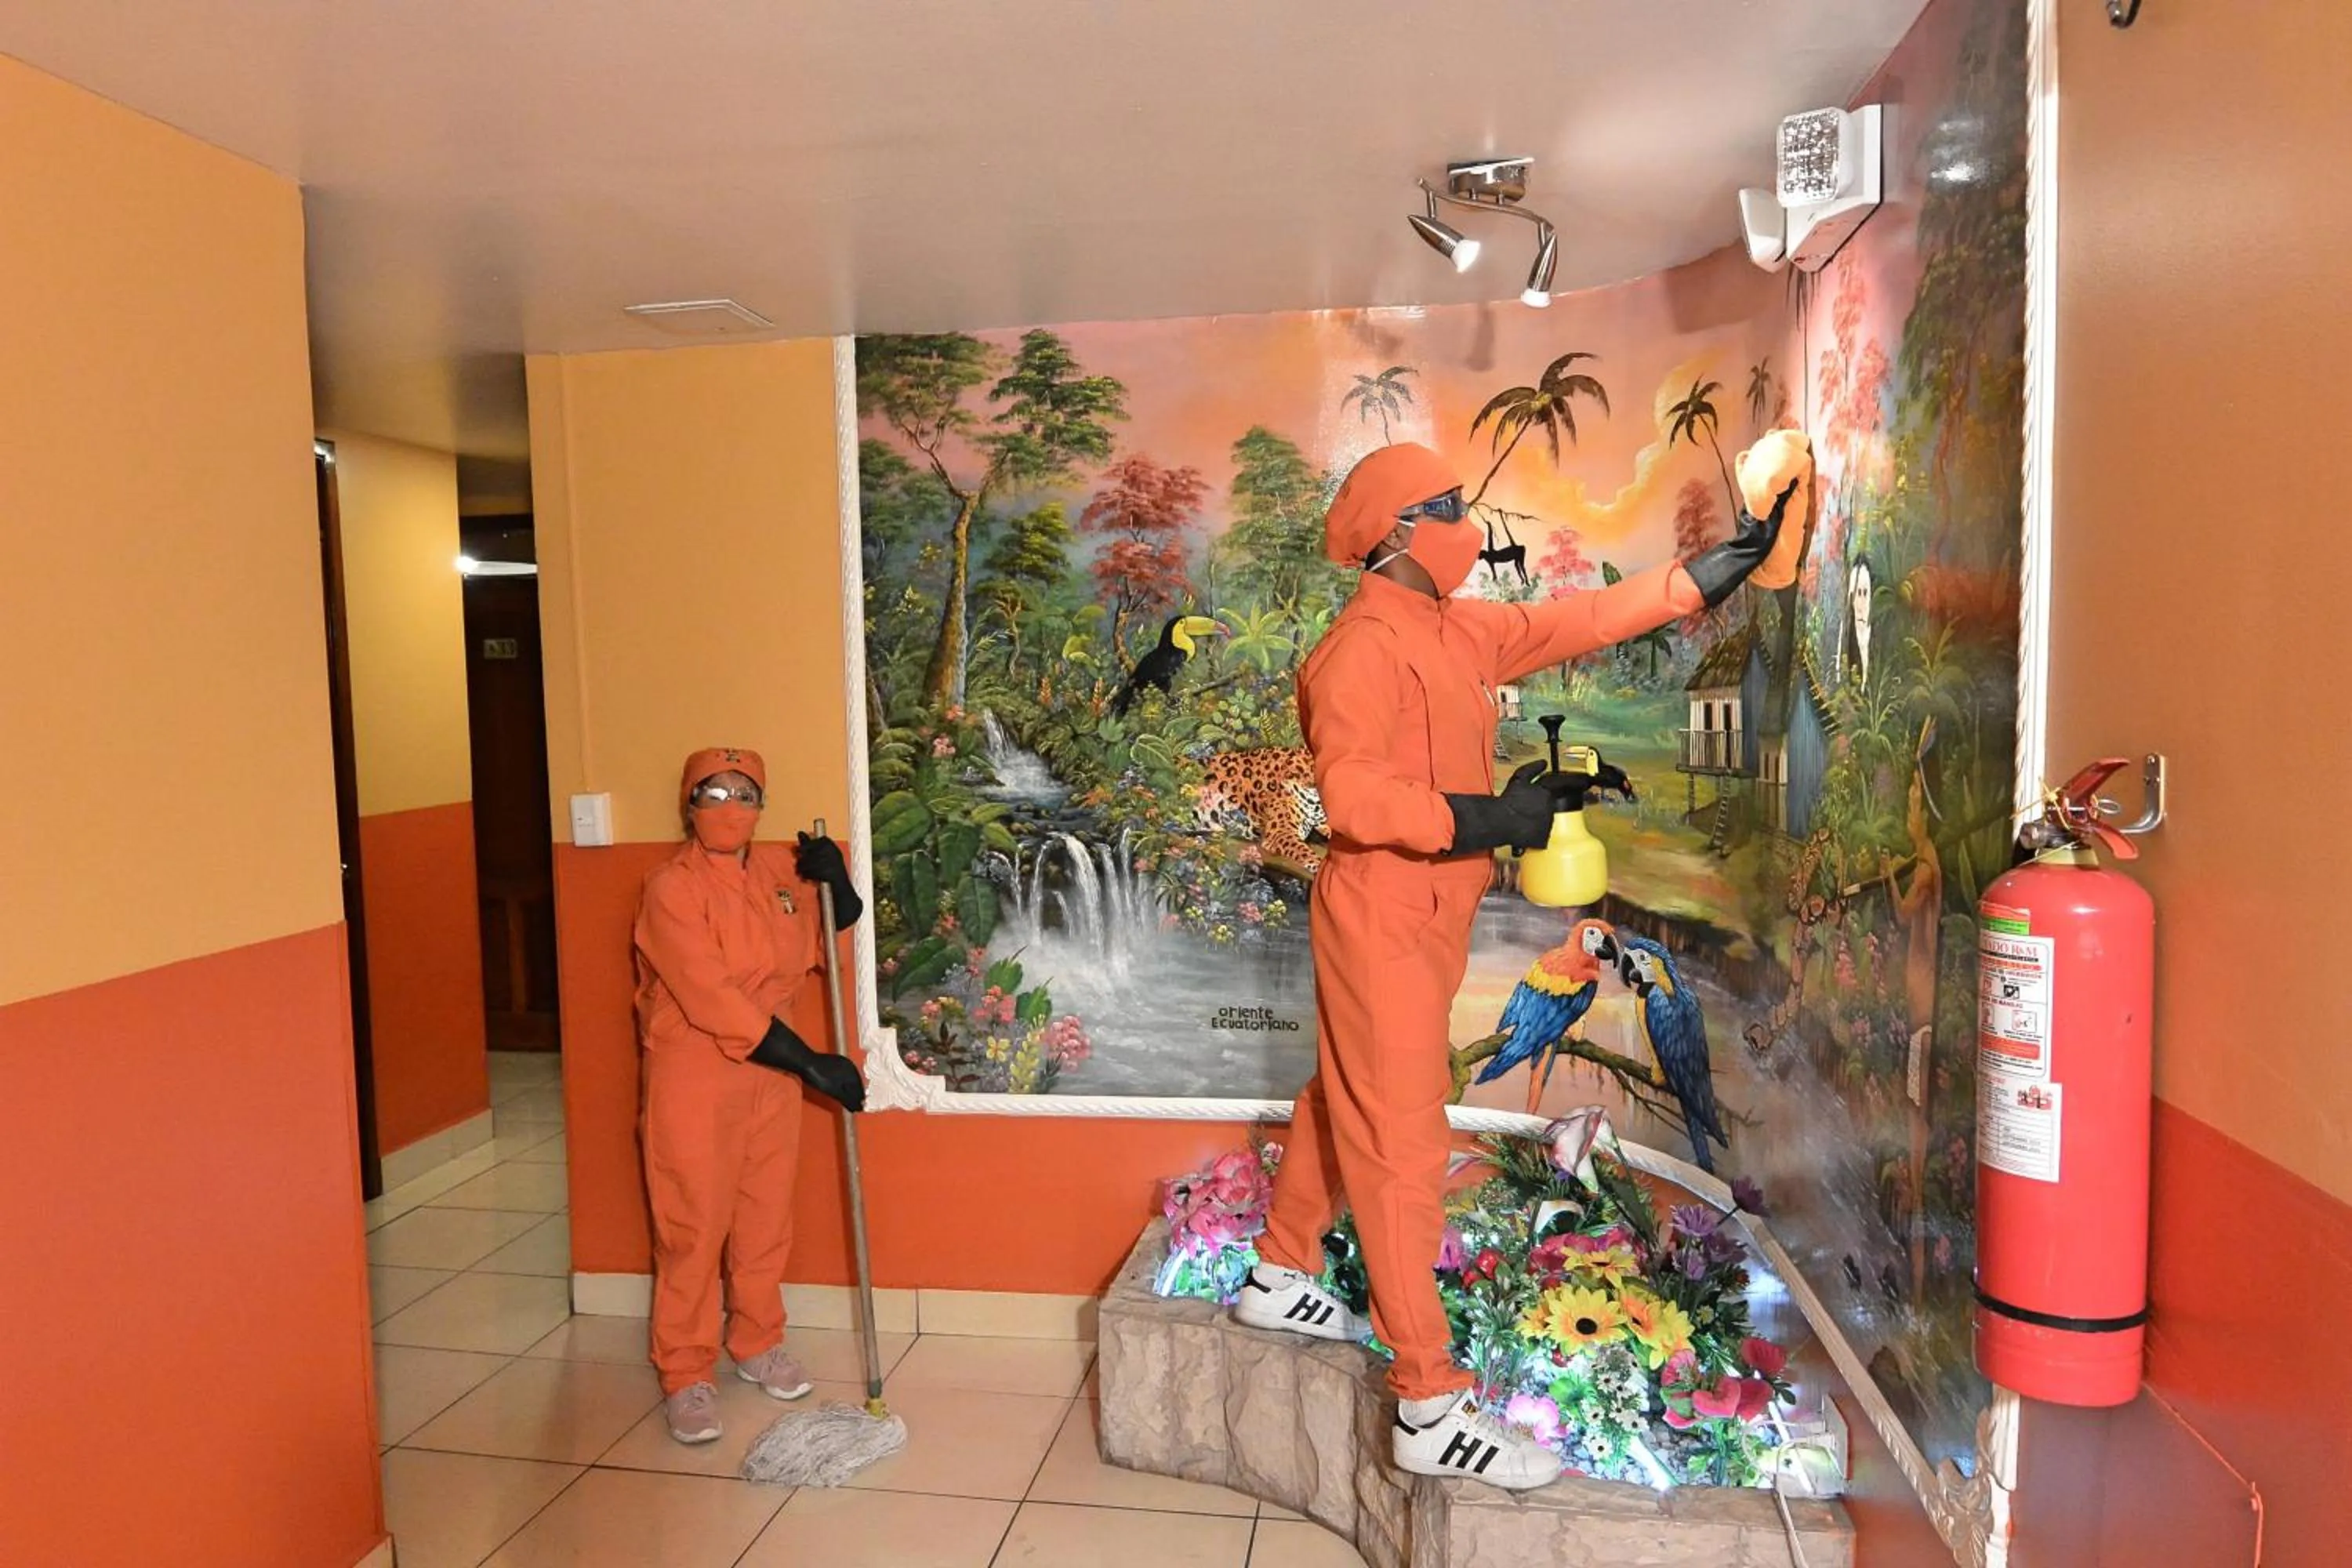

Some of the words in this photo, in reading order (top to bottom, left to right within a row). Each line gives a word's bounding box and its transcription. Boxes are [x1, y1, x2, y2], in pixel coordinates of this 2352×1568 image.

[1211, 1018, 1299, 1031] Ecuatoriano
[1284, 1294, 1334, 1326] HI
[1439, 1430, 1500, 1475] HI
